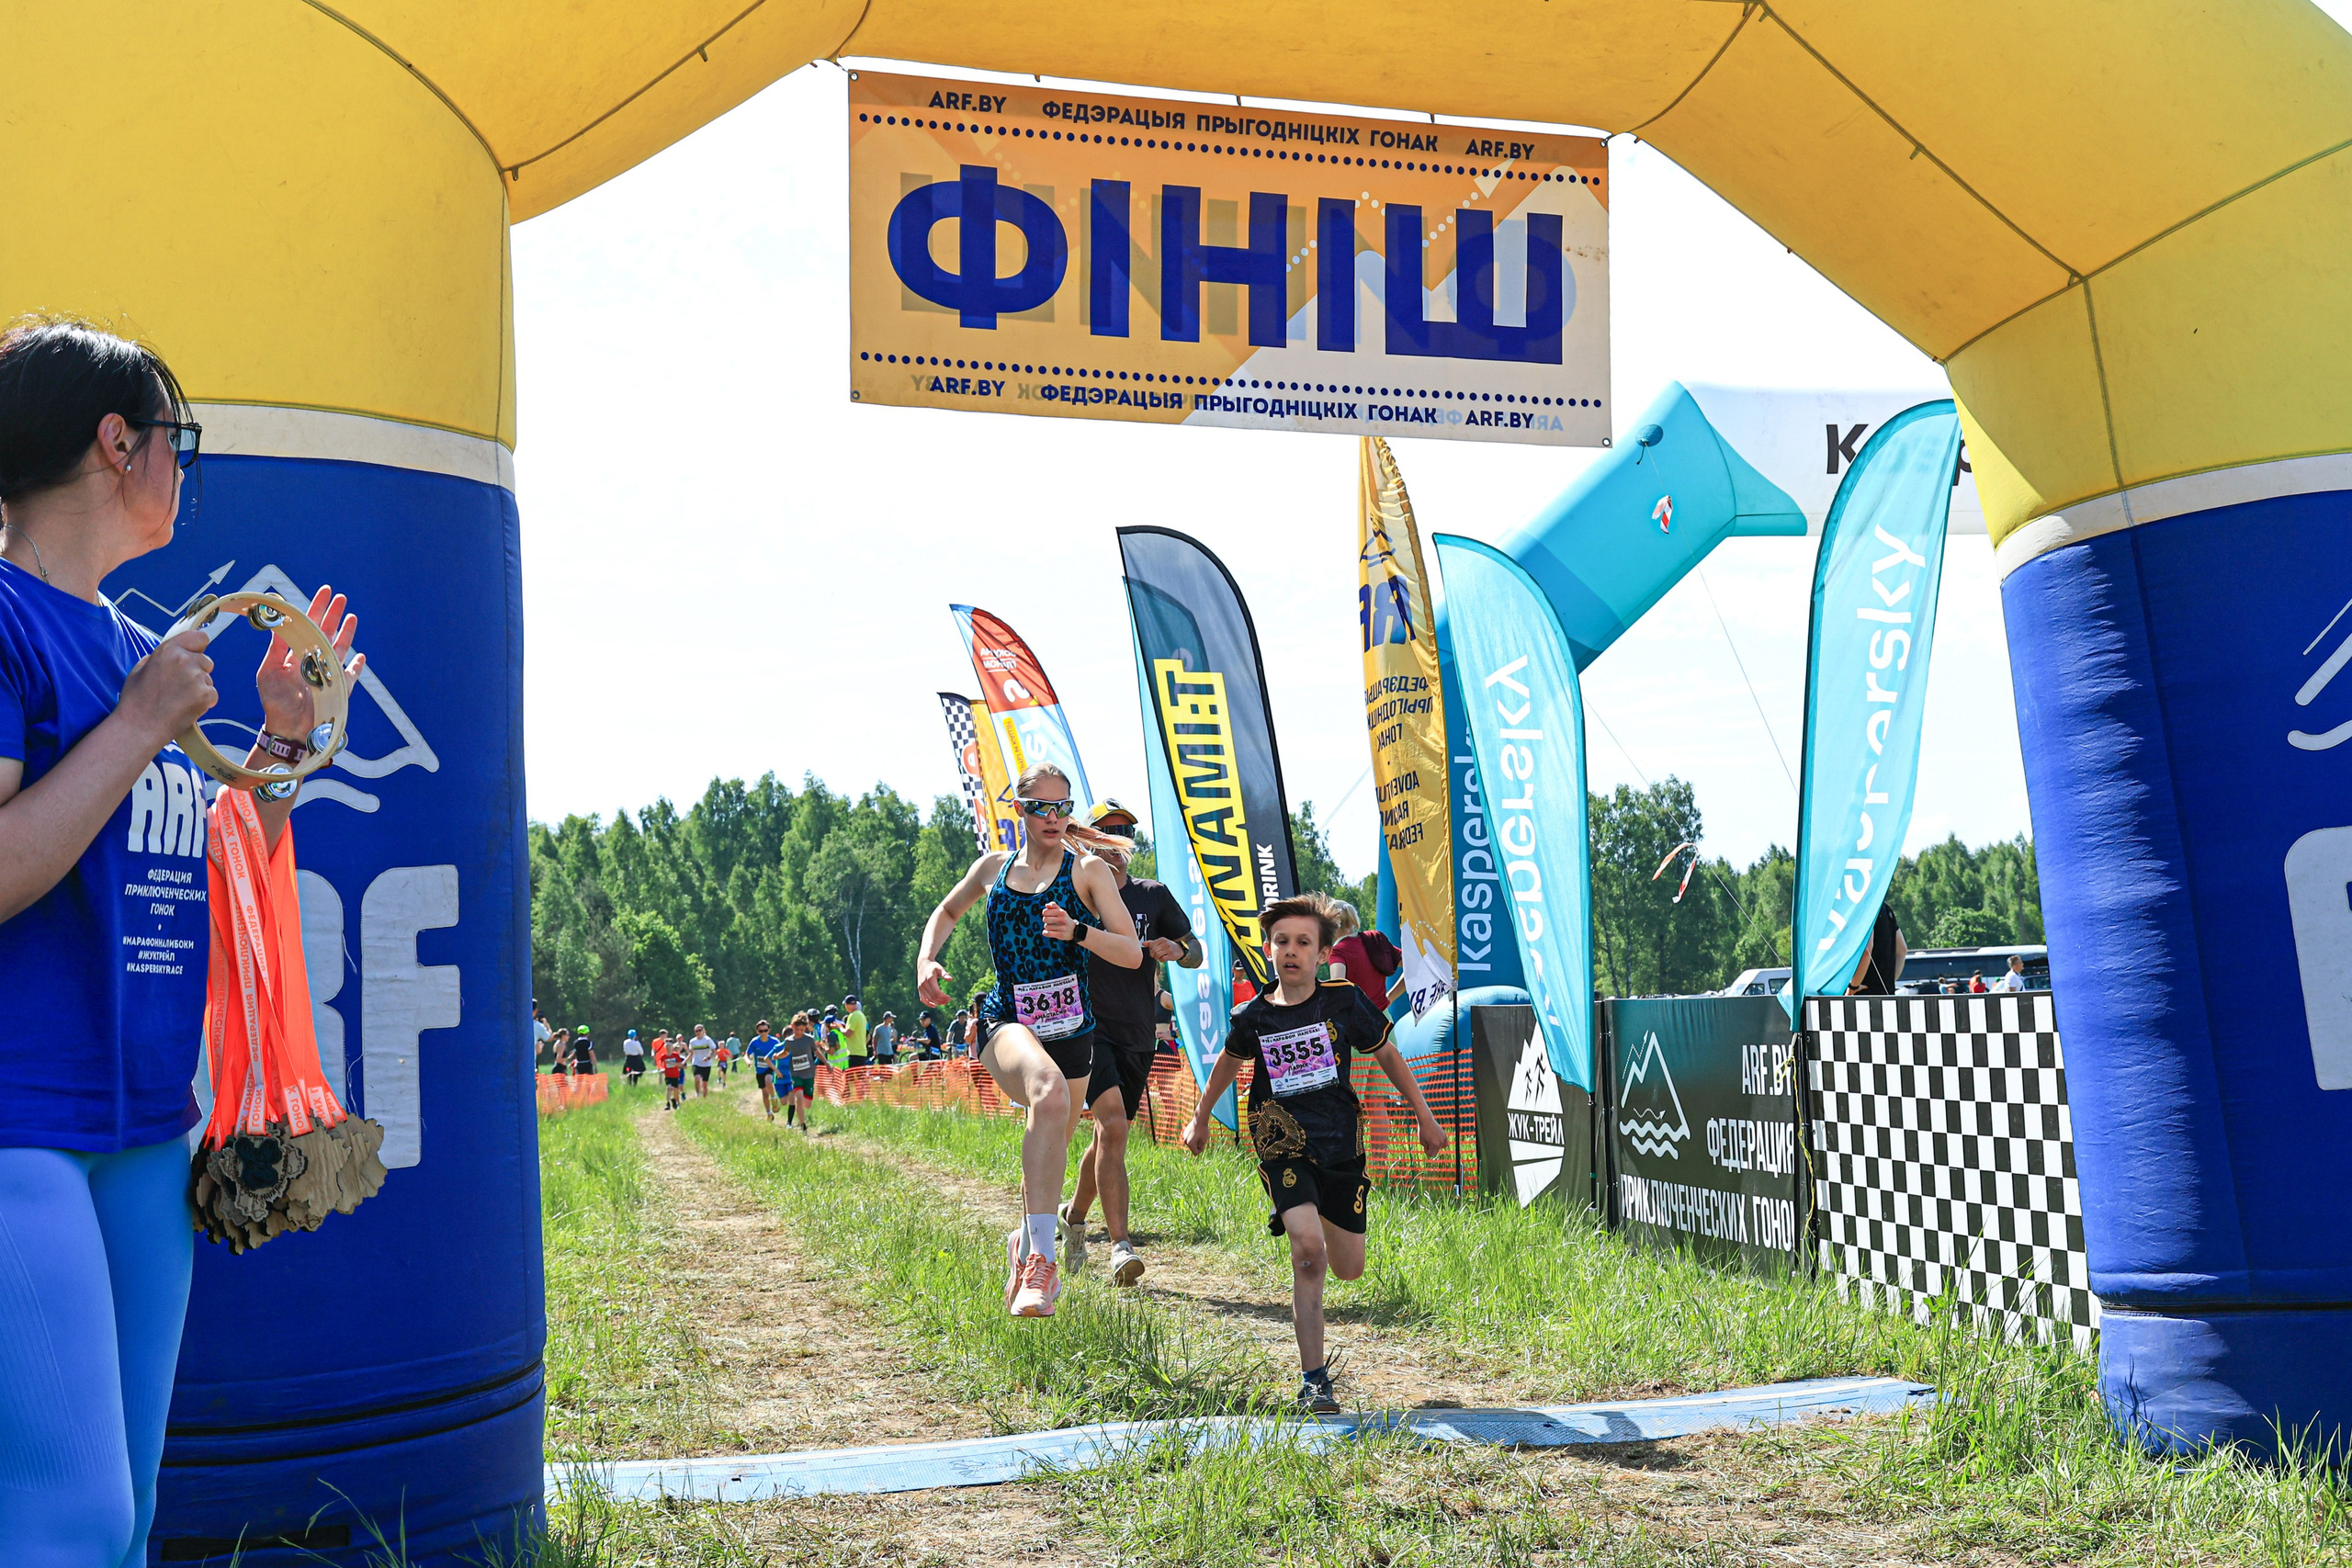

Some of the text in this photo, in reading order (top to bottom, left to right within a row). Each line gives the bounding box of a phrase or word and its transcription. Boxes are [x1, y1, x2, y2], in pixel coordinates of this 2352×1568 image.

[929, 91, 1534, 160] ARF.BY ФЕДЭРАЦЫЯ ПРЫГОДНІЦКІХ ГОНАК ARF.BY
[888, 164, 1563, 365] ФІНІШ
[930, 376, 1005, 397] ARF.BY
[1041, 384, 1182, 410] ФЕДЭРАЦЫЯ
[1194, 394, 1358, 420] ПРЫГОДНІЦКІХ
[1368, 404, 1437, 424] ГОНАК
[1464, 410, 1534, 429] ARF.BY
[237, 790, 254, 823] ГОНО
[147, 868, 192, 886] ФЕДЕРАЦИЯ
[229, 841, 246, 880] ГОНОК
[125, 884, 207, 902] ПРИКЛЮЧЕНЧЕСКИХ
[150, 902, 175, 917] ГОНОК
[246, 905, 266, 972] ФЕДЕРАЦИЯ
[127, 962, 183, 975] #KASPERSKYRACE
[1022, 987, 1075, 1014] 3618
[245, 993, 258, 1062] ФЕДЕРАЦИЯ
[1270, 1037, 1324, 1066] 3555
[1742, 1044, 1792, 1096] ARF.BY
[251, 1089, 263, 1127] ГОНОК
[1508, 1111, 1564, 1145] ЖУК-ТРЕЙЛ
[1706, 1117, 1794, 1179] ФЕДЕРАЦИЯ
[1752, 1195, 1794, 1252] ГОНО
